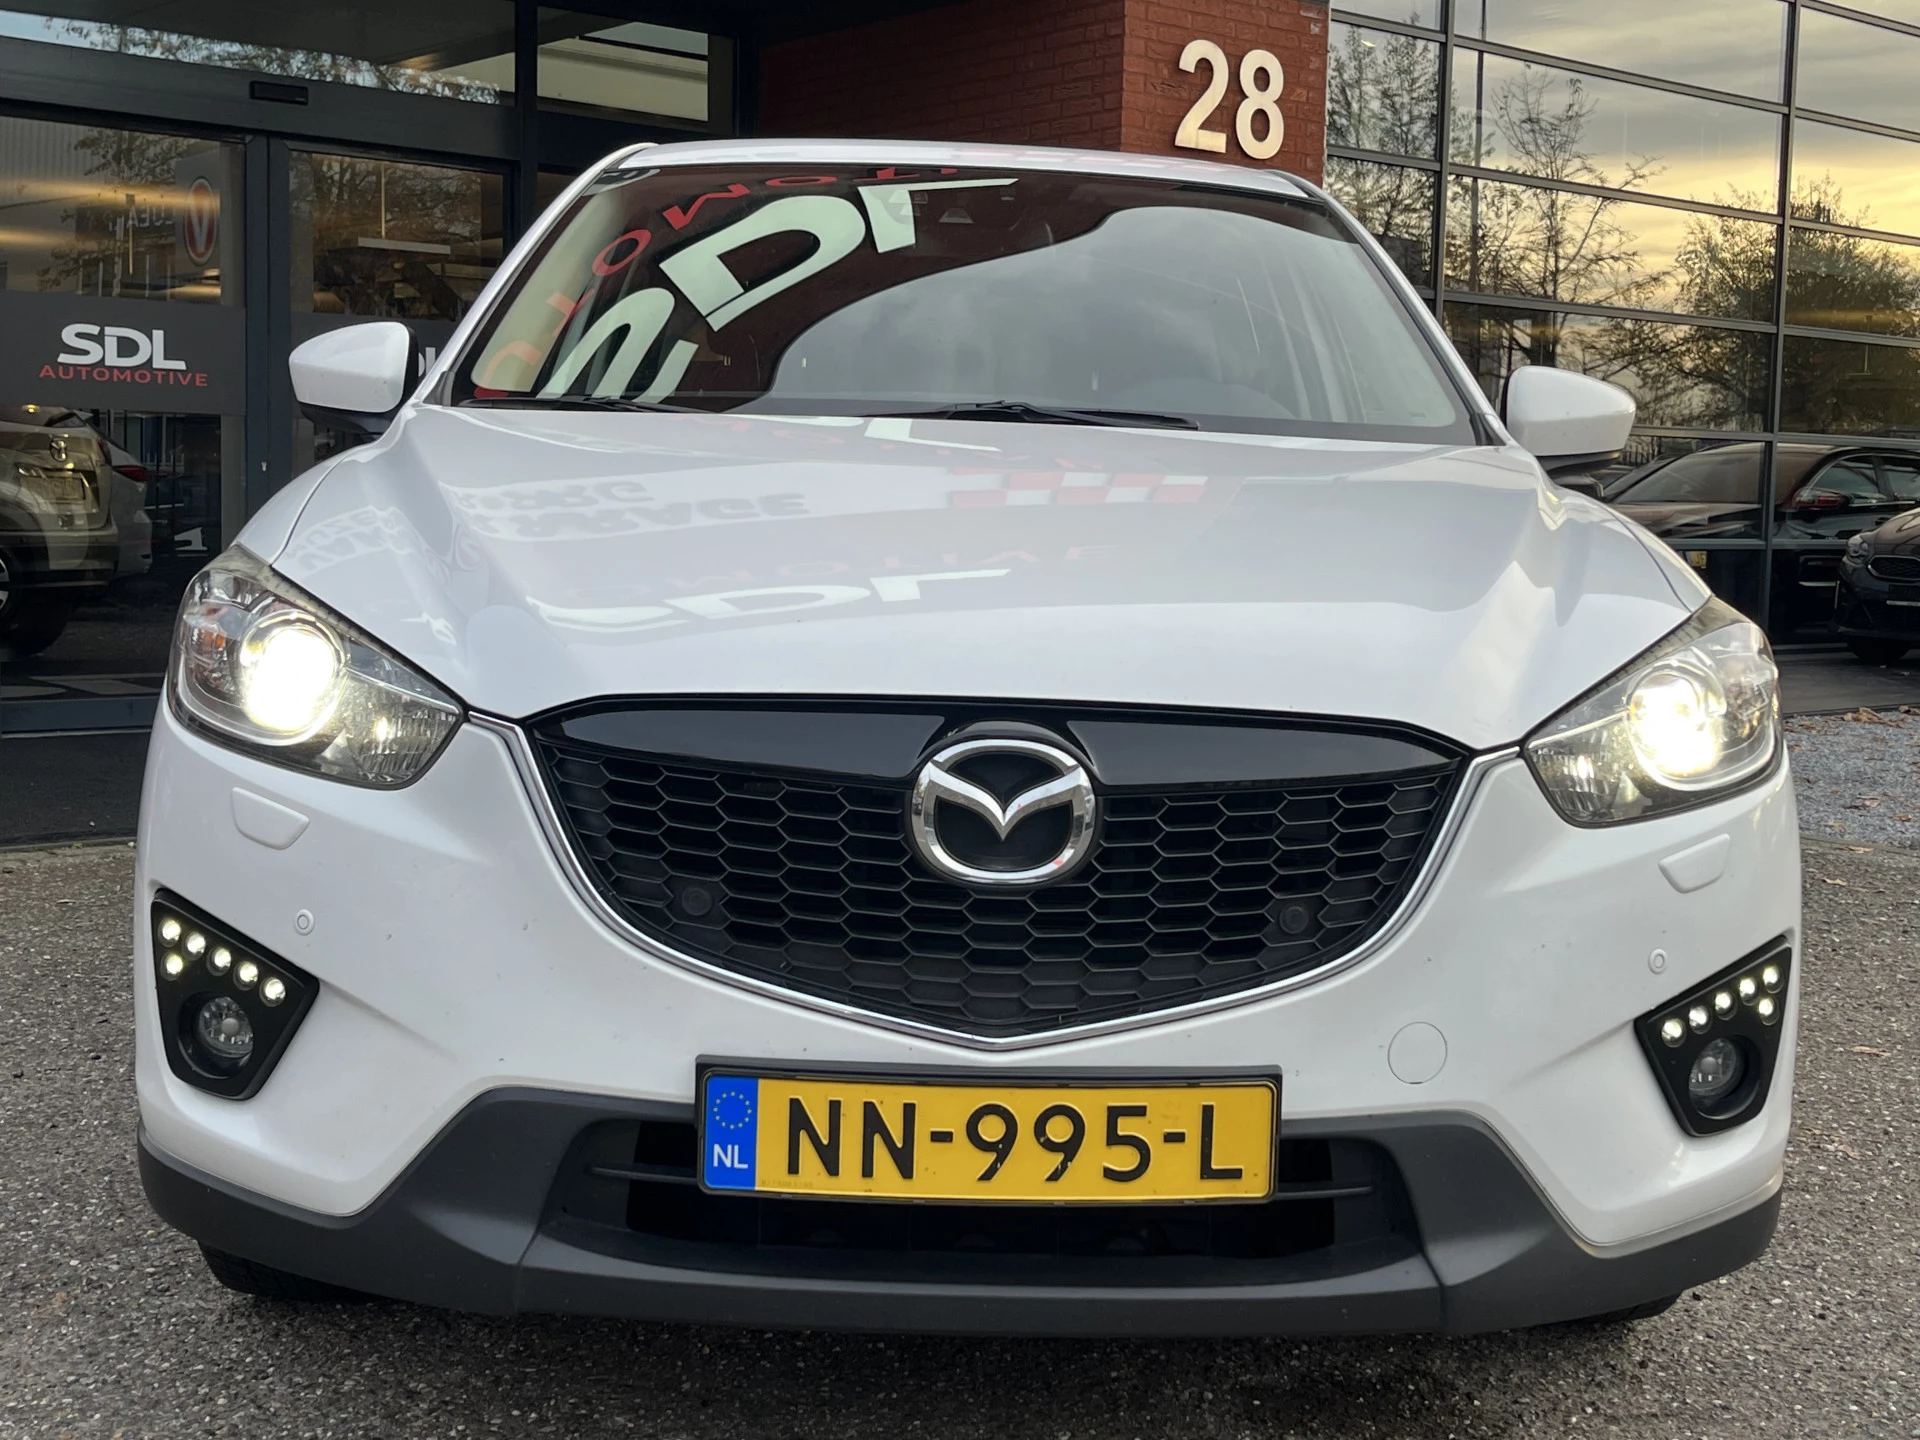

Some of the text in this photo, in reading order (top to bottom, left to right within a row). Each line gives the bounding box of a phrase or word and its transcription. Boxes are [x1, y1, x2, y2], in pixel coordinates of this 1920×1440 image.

[1174, 39, 1285, 160] 28
[57, 323, 187, 371] SDL
[39, 364, 209, 387] AUTOMOTIVE
[712, 1143, 749, 1170] NL
[786, 1096, 1244, 1182] NN-995-L
